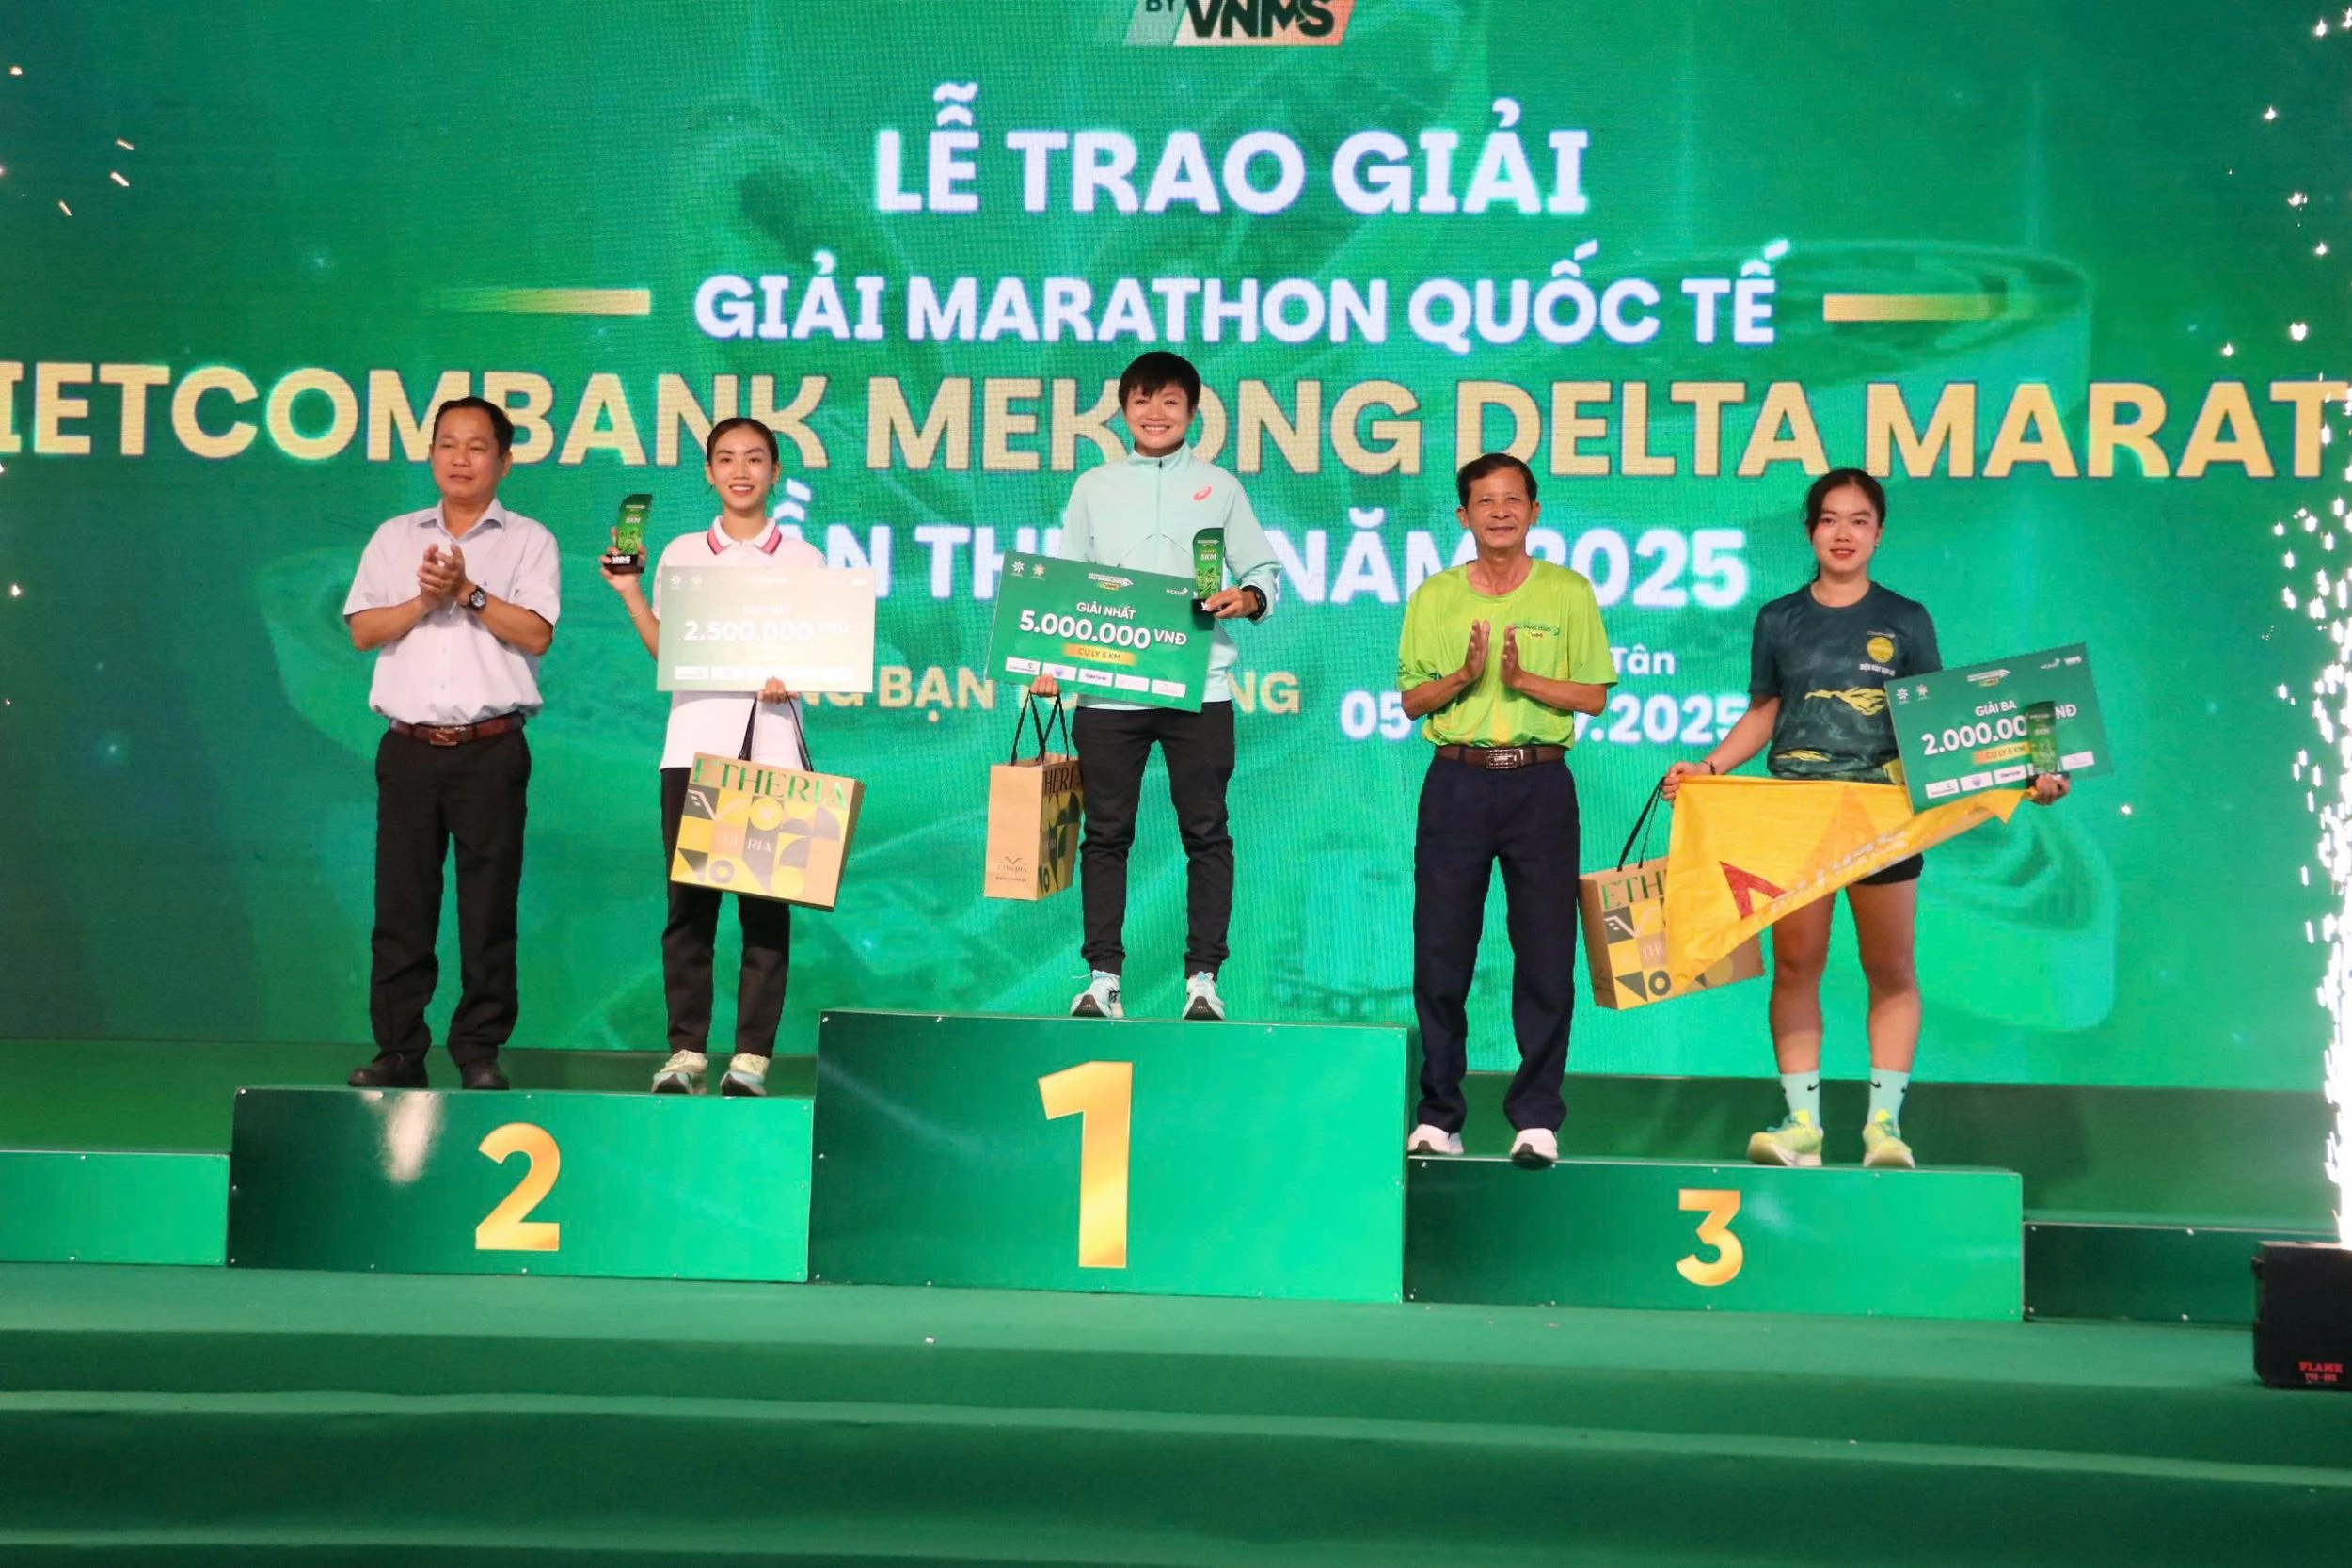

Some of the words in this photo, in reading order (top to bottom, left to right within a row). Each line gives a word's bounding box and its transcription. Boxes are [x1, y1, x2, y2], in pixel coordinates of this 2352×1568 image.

[875, 82, 979, 214] LỄ
[1008, 129, 1306, 214] TRAO
[1331, 99, 1590, 214] GIẢI
[693, 250, 884, 342] GIẢI
[908, 276, 1389, 345] MARATHON
[1408, 240, 1661, 355] QUỐC
[1680, 239, 1789, 344] TẾ
[1455, 380, 1829, 477] DELTA
[1864, 381, 2349, 478] MARAT
[1019, 610, 1152, 649] 5.000.000
[1153, 628, 1187, 645] VNĐ
[1076, 601, 1103, 614] GIẢI
[1104, 605, 1136, 620] NHẤT
[1108, 653, 1121, 661] KM
[878, 665, 995, 722] BẠN
[1975, 702, 1999, 717] GIẢI
[2001, 700, 2017, 712] BA
[1921, 715, 2027, 755] 2.000.00
[692, 756, 847, 809] ETHERIA
[1043, 766, 1080, 794] HERI
[747, 838, 772, 852] RIA
[475, 1122, 560, 1251] 2
[1038, 1061, 1133, 1269] 1
[1676, 1189, 1743, 1287] 3
